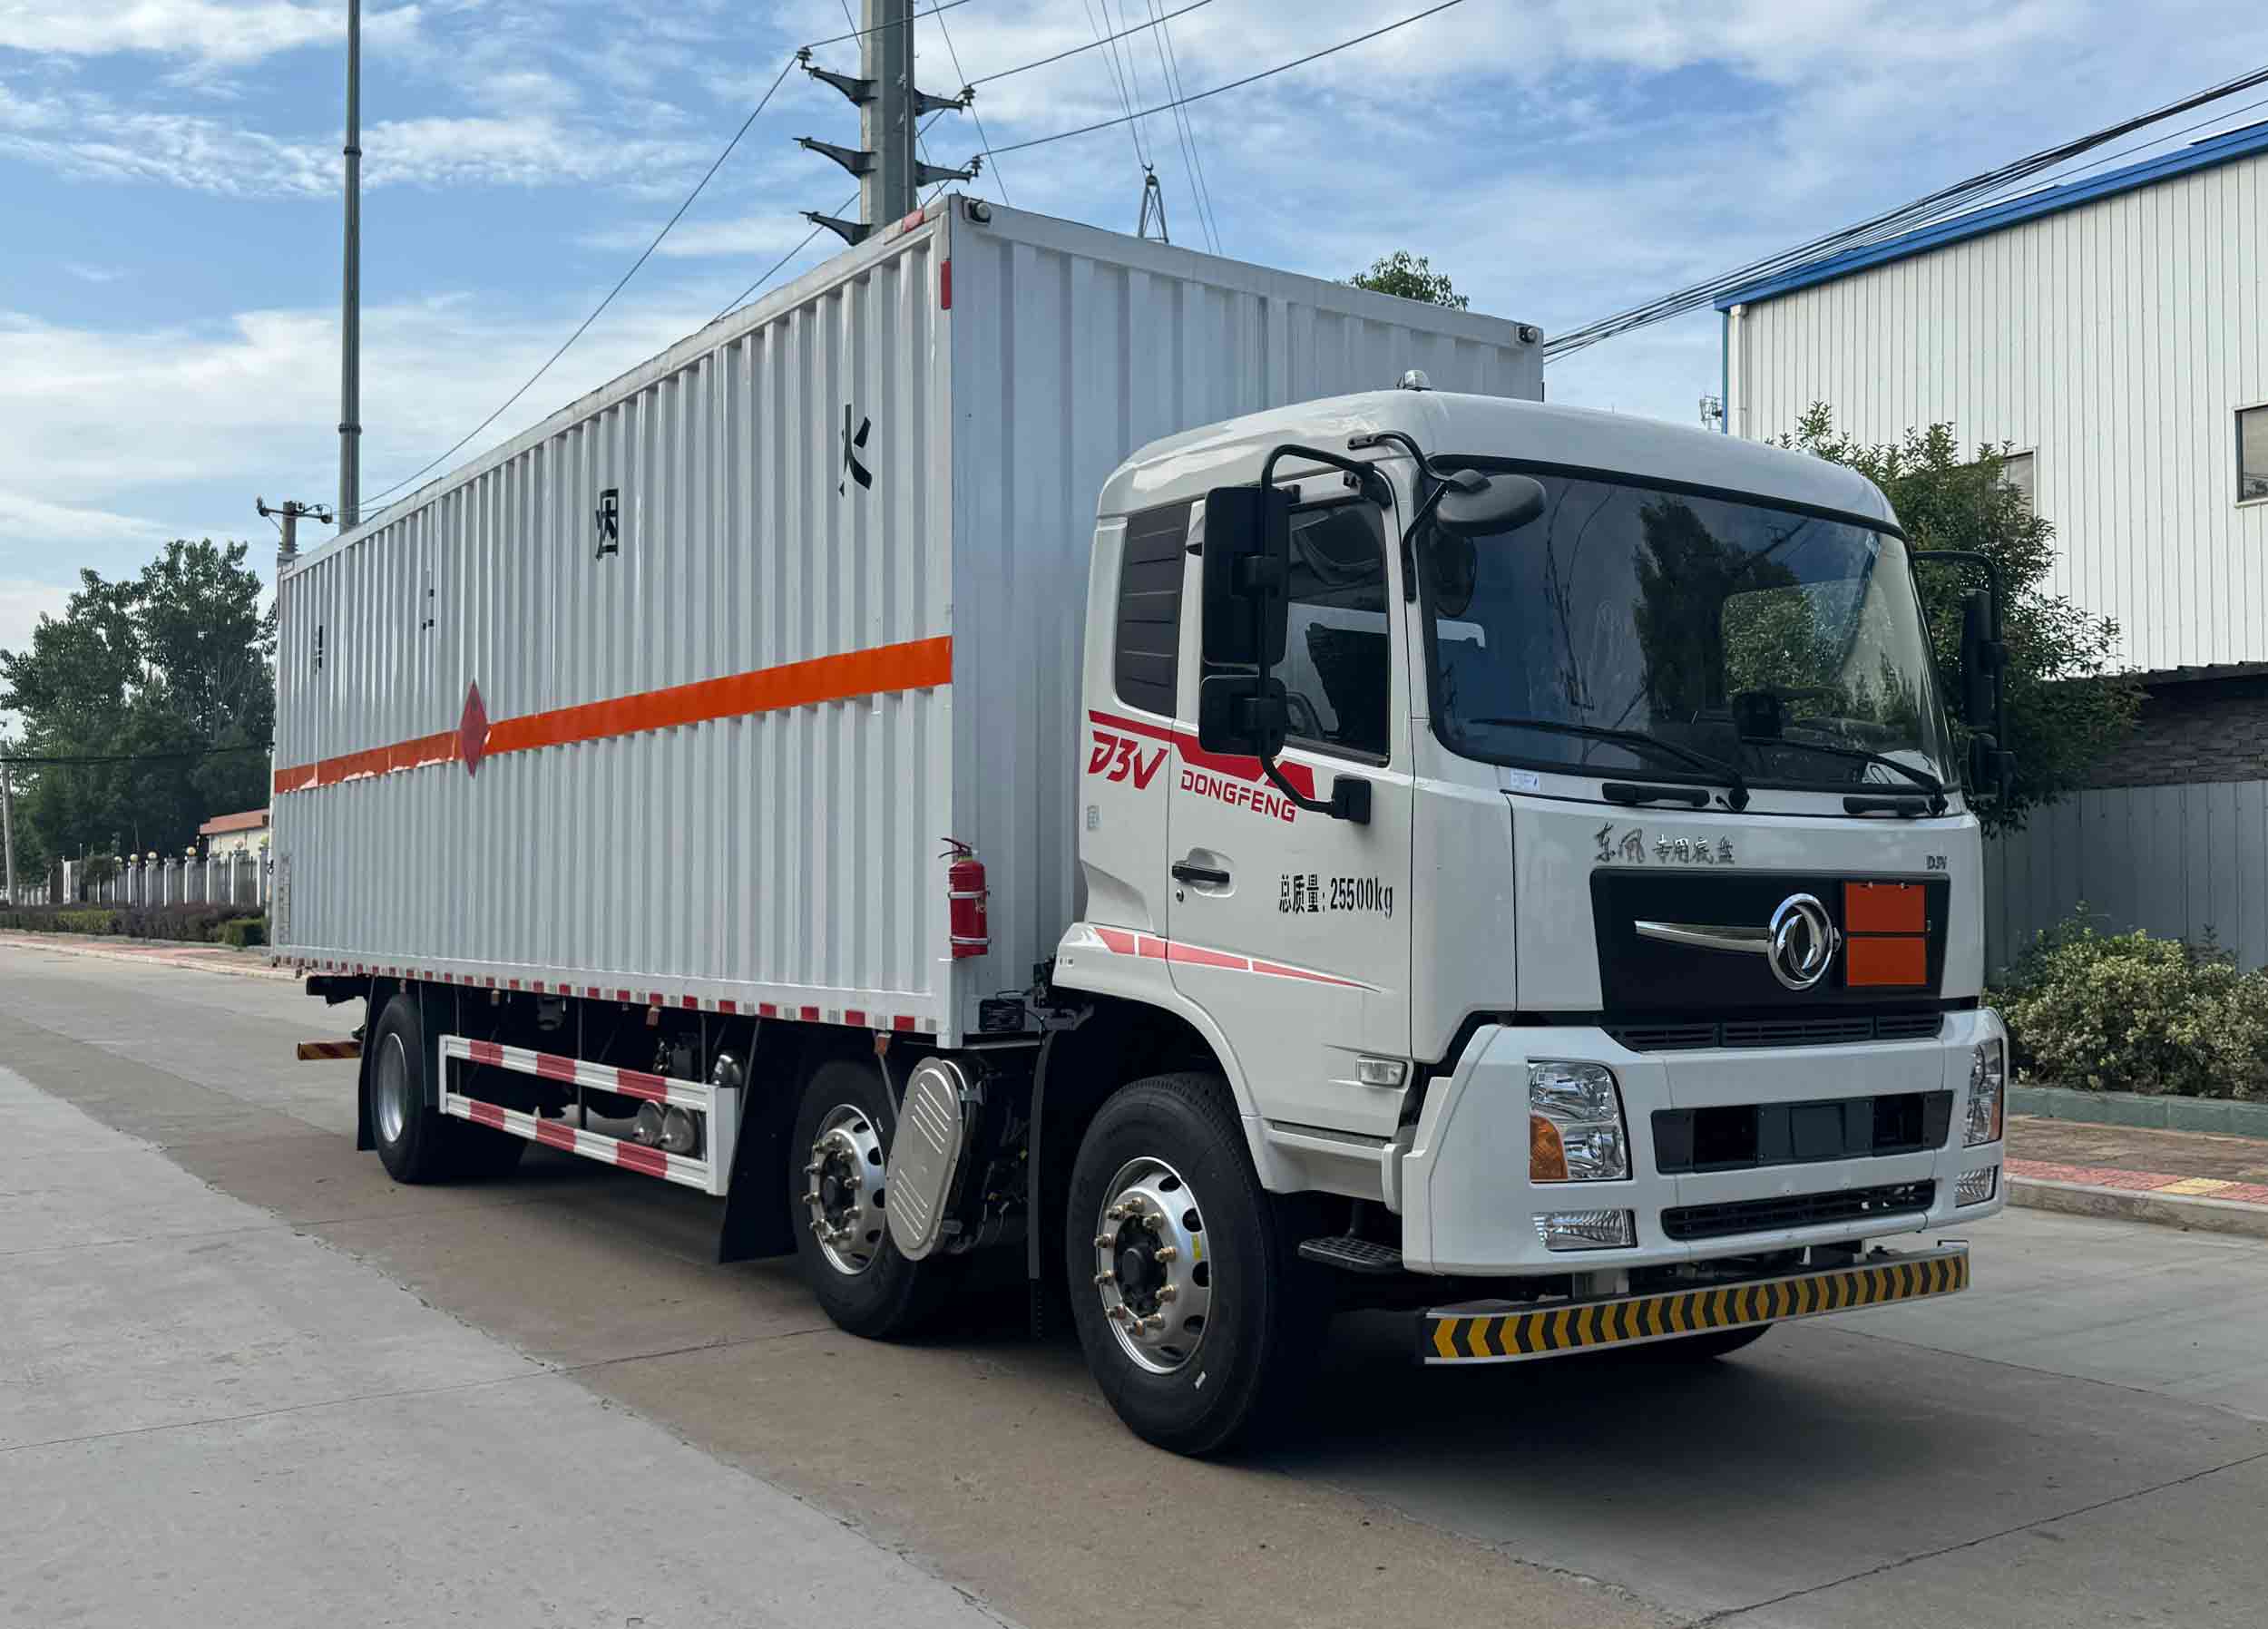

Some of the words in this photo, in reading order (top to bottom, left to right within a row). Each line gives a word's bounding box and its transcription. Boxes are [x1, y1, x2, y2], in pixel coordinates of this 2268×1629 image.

[1088, 730, 1169, 790] D3V
[1180, 769, 1297, 823] DONGFENG
[1593, 821, 1646, 863] 东风
[1329, 874, 1393, 920] 25500kg
